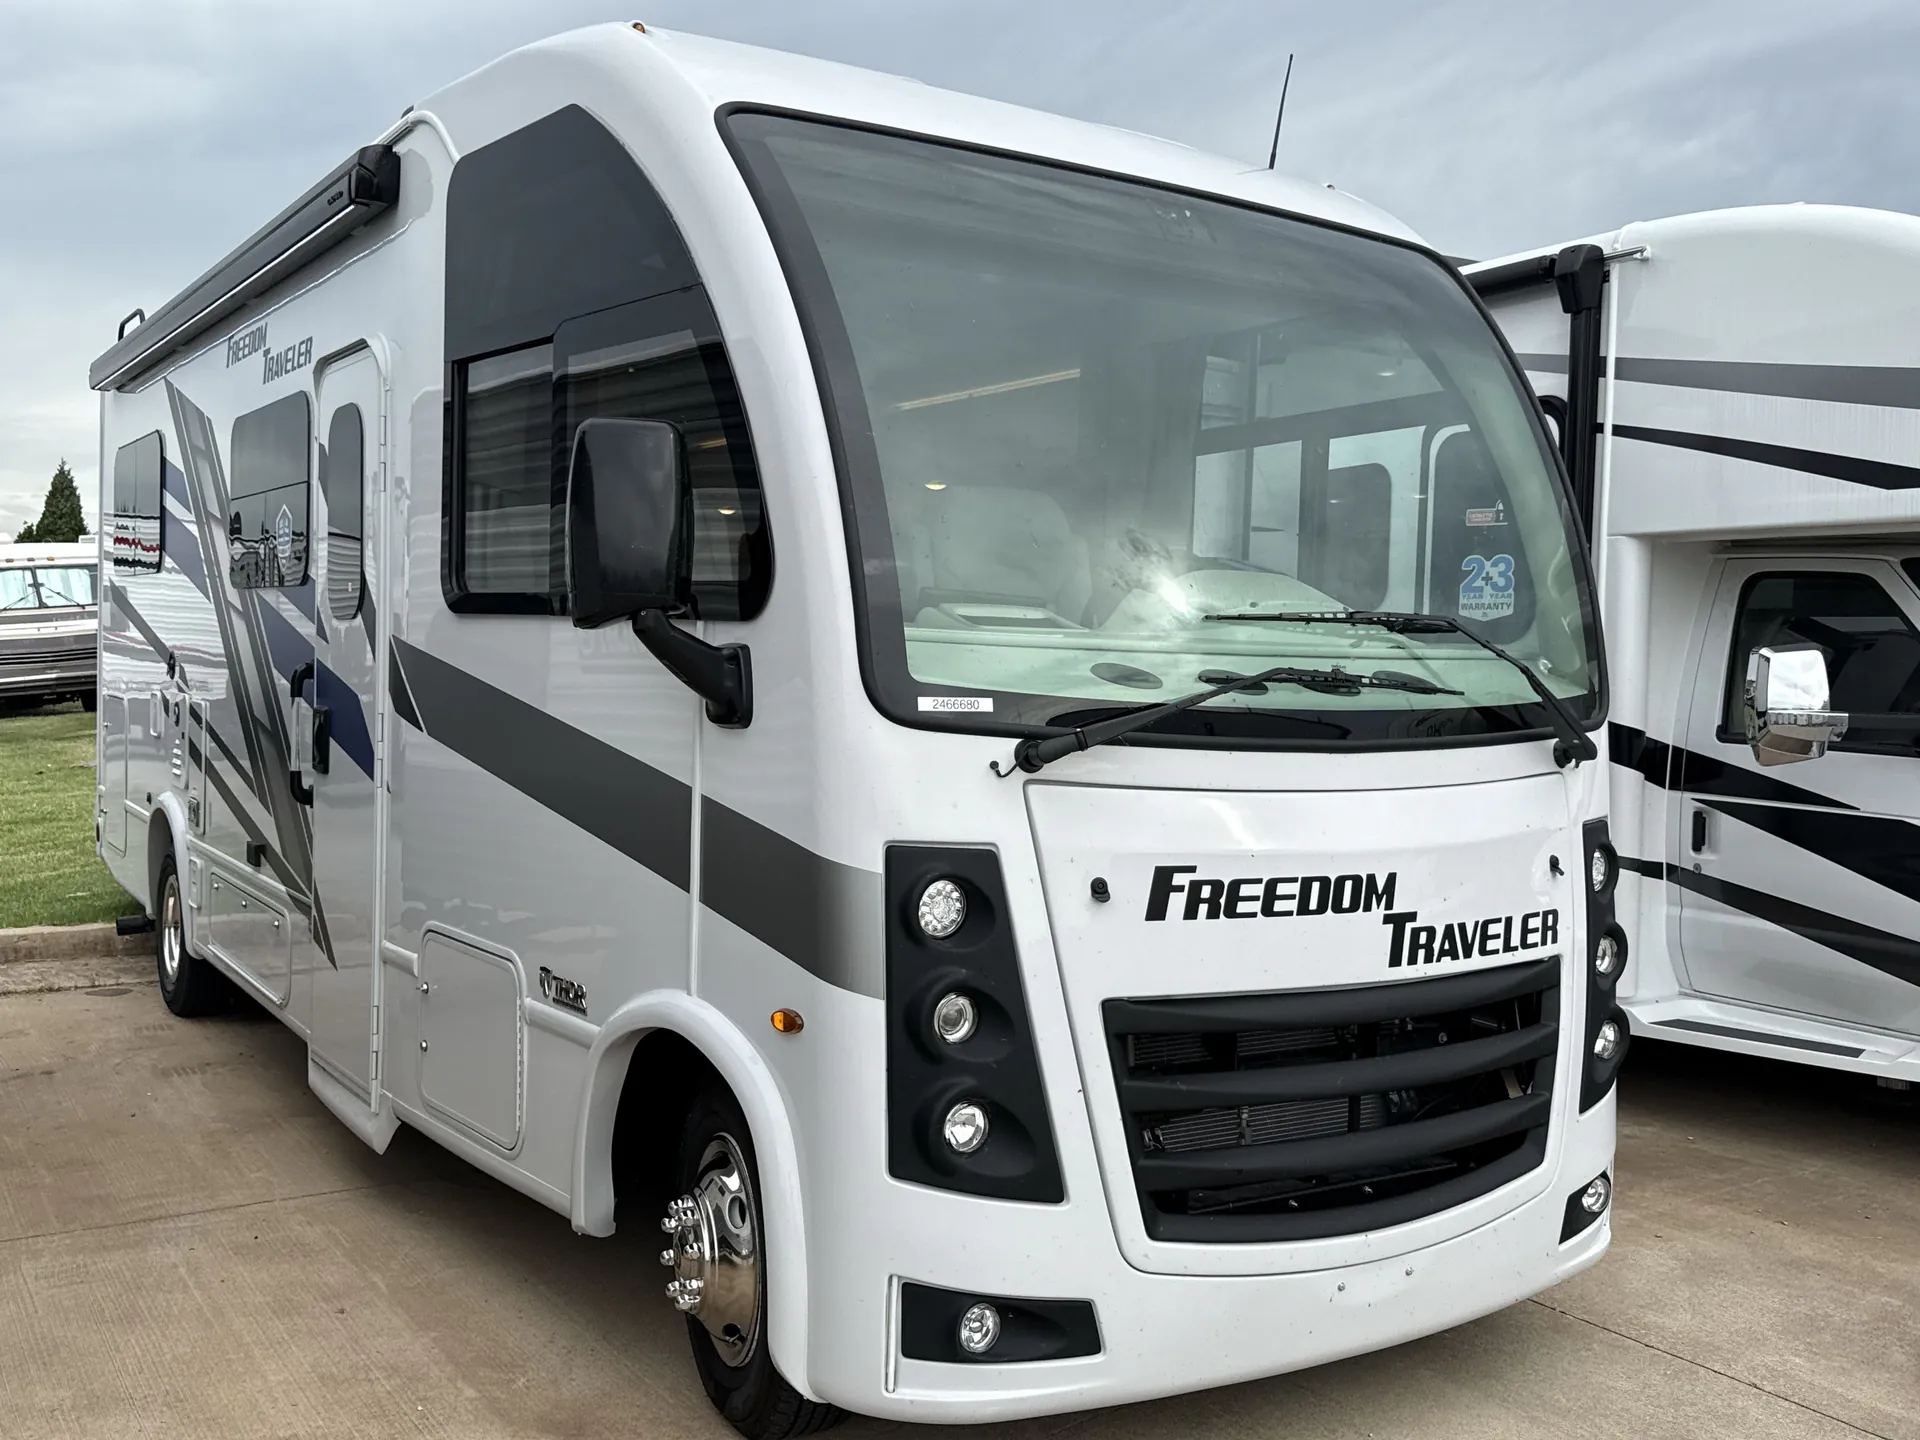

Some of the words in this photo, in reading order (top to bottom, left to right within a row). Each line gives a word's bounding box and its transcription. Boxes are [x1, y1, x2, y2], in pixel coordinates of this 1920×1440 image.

[226, 322, 268, 368] FREEDOM
[263, 336, 313, 385] TRAVELER
[1460, 602, 1513, 611] WARRANTY
[1461, 592, 1484, 600] YEAR
[1489, 592, 1513, 600] YEAR
[932, 699, 980, 710] 2466680
[1145, 865, 1397, 921] FREEDOM
[1382, 909, 1559, 968] TRAVELER
